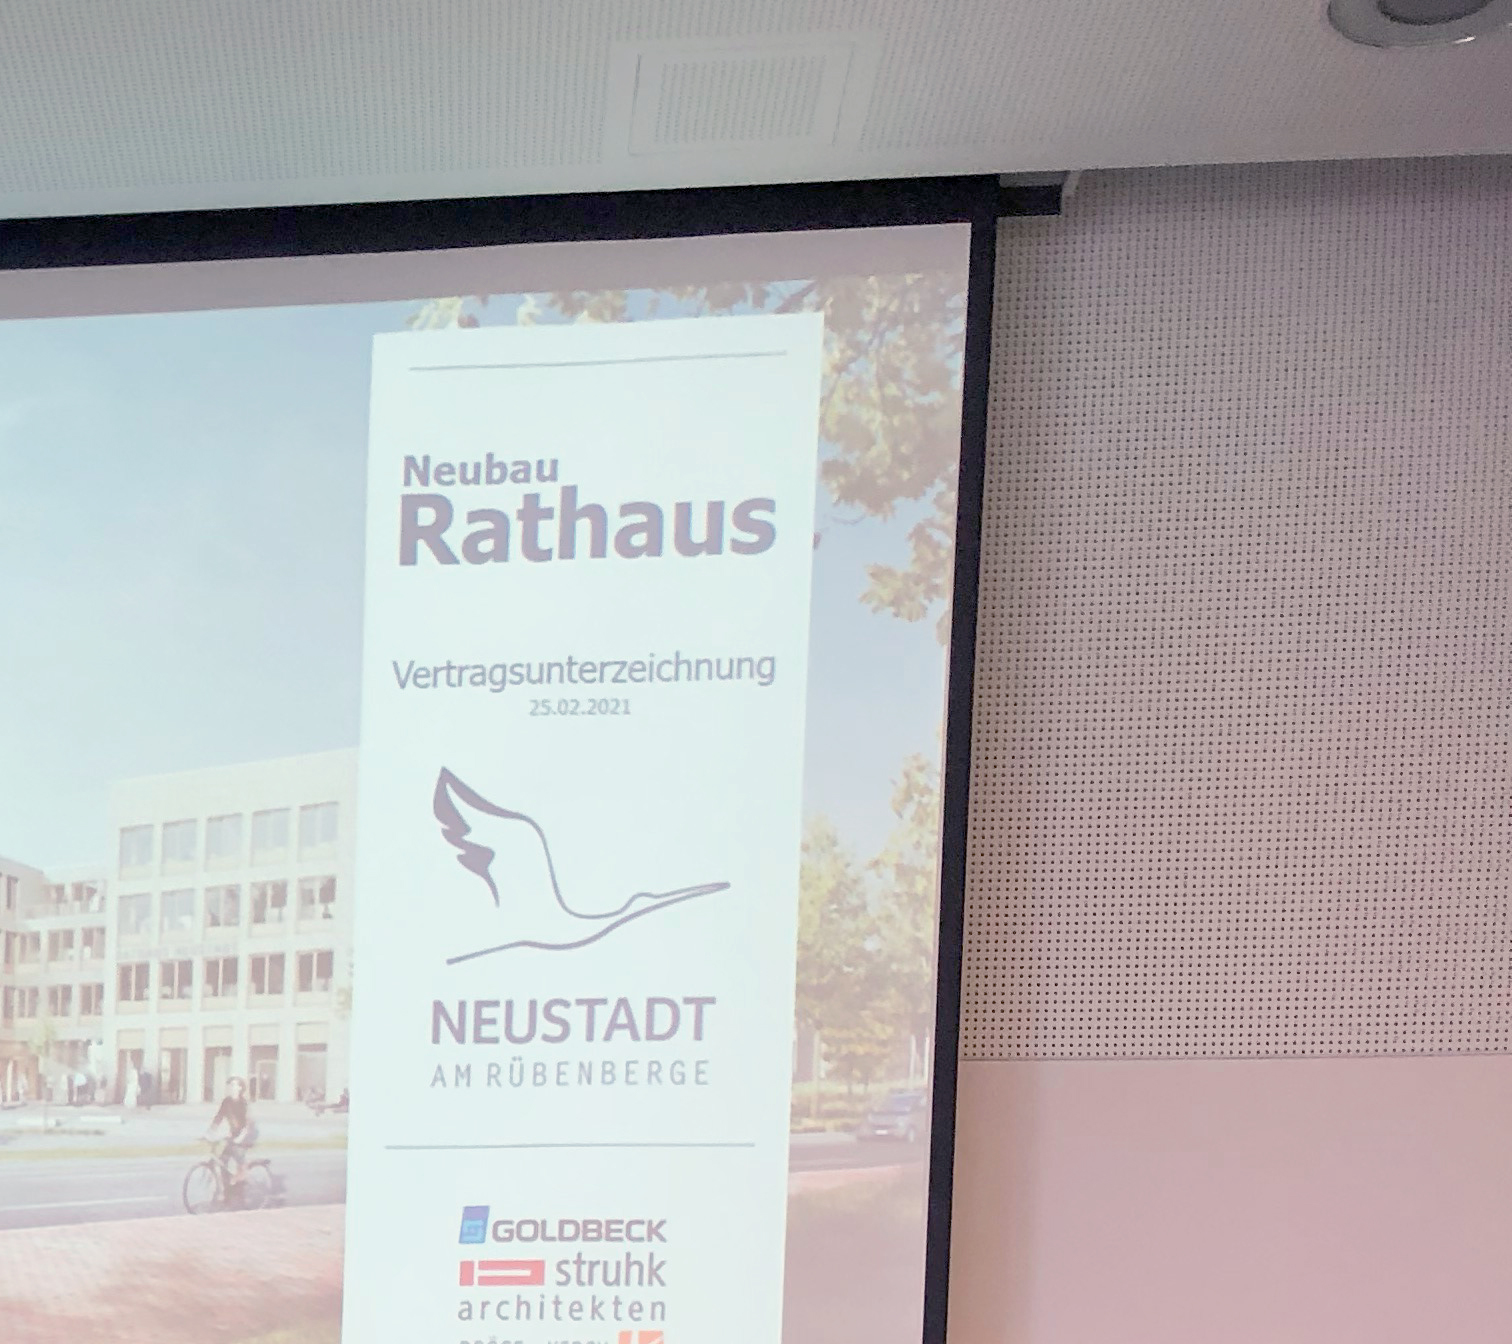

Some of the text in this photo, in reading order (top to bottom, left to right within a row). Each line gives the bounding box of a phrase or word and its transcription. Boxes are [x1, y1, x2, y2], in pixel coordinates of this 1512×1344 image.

[402, 453, 559, 487] Neubau
[399, 484, 778, 567] Rathaus
[392, 650, 776, 693] Vertragsunterzeichnung
[529, 697, 631, 716] 25.02.2021
[431, 995, 716, 1045] NEUSTADT
[430, 1056, 710, 1089] AM RÜBENBERGE
[491, 1218, 668, 1244] GOLDBECK
[555, 1251, 667, 1288] struhk
[457, 1293, 666, 1322] architekten
